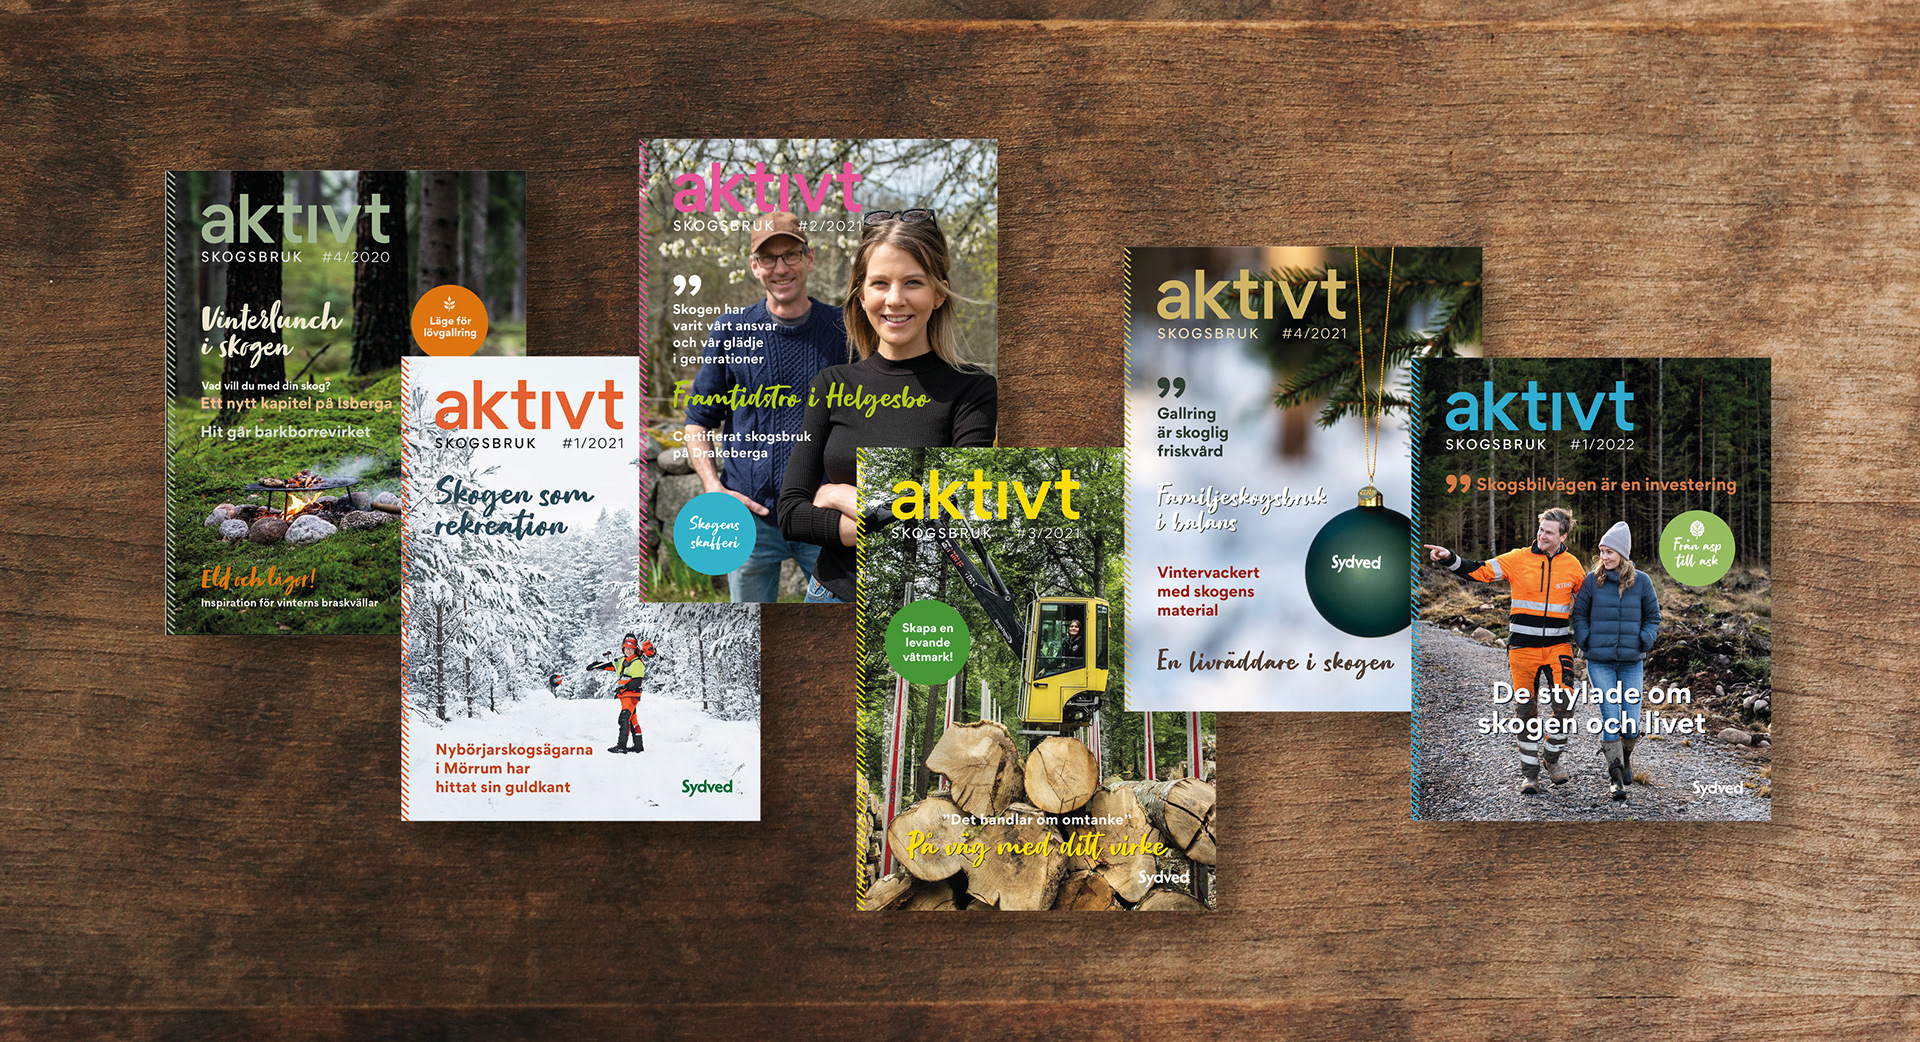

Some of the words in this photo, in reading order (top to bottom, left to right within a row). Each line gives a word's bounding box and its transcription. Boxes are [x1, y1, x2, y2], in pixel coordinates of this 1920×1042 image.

[673, 162, 862, 213] aktivt
[201, 193, 390, 243] aktivt
[673, 220, 774, 232] SKOGSBRUK
[798, 220, 862, 232] #2/2021
[201, 251, 302, 263] SKOGSBRUK
[322, 251, 390, 264] #4/2020
[1157, 269, 1346, 320] aktivt
[201, 300, 343, 332] Vinterlunch
[673, 304, 721, 318] Skogen
[724, 303, 745, 315] har
[430, 316, 454, 328] Läge
[456, 316, 472, 326] för
[673, 320, 703, 331] varit
[706, 319, 733, 331] vårt
[736, 321, 778, 331] ansvar
[424, 327, 477, 339] lövgallring
[1157, 327, 1259, 339] SKOGSBRUK
[1282, 327, 1346, 339] #4/2021
[201, 337, 213, 357] i
[219, 334, 294, 368] skogen
[673, 337, 697, 348] och
[700, 336, 721, 348] vår
[724, 337, 764, 351] glädje
[673, 353, 677, 364] i
[680, 353, 764, 367] generationer
[202, 381, 222, 391] Vad
[224, 381, 240, 391] vill
[241, 381, 255, 391] du
[257, 381, 280, 391] med
[282, 381, 298, 391] din
[301, 381, 331, 393] skog?
[201, 397, 223, 410] Ett
[226, 397, 257, 413] nytt
[261, 396, 312, 413] kapitel
[316, 395, 334, 413] på
[338, 396, 392, 413] Isberga
[435, 379, 624, 430] aktivt
[673, 380, 802, 412] Framtidstro
[808, 386, 819, 408] i
[826, 382, 931, 418] Helgesbo
[1446, 381, 1634, 431] aktivt
[1157, 407, 1216, 423] Gallring
[201, 425, 223, 438] Hit
[227, 424, 252, 441] går
[255, 425, 371, 438] barkborrevirket
[673, 430, 742, 442] Certifierat
[745, 430, 811, 445] skogsbruk
[1157, 426, 1172, 439] är
[1176, 426, 1229, 442] skoglig
[435, 437, 536, 449] SKOGSBRUK
[562, 437, 624, 449] #1/2021
[1157, 444, 1223, 457] friskvård
[1445, 438, 1547, 450] SKOGSBRUK
[1570, 438, 1634, 450] #1/2022
[673, 446, 689, 461] på
[693, 447, 768, 461] Drakeberga
[1477, 477, 1596, 495] Skogsbilvägen
[1601, 479, 1617, 492] är
[1621, 481, 1640, 492] en
[1645, 477, 1737, 495] investering
[435, 475, 533, 516] Skogen
[539, 488, 595, 507] som
[891, 469, 1080, 520] aktivt
[1156, 481, 1328, 514] Familjeskogsbruk
[435, 509, 568, 541] rekreation
[689, 515, 740, 539] Skogens
[1155, 513, 1167, 531] i
[1171, 511, 1238, 533] balans
[891, 527, 992, 539] SKOGSBRUK
[1017, 527, 1081, 539] #3/2021
[690, 535, 740, 550] skafferi
[1673, 536, 1699, 552] Från
[1702, 543, 1722, 555] asp
[1331, 555, 1381, 573] Sydved
[1675, 553, 1697, 569] till
[1699, 555, 1719, 567] ask
[201, 566, 232, 589] Eld
[234, 567, 269, 586] och
[267, 565, 316, 595] lågor!
[1157, 566, 1260, 579] Vintervackert
[1157, 585, 1190, 598] med
[1194, 585, 1255, 601] skogens
[201, 598, 257, 610] Inspiration
[259, 598, 275, 607] för
[277, 598, 319, 607] vinterns
[322, 598, 378, 608] braskvällar
[1157, 604, 1218, 617] material
[902, 622, 937, 636] Skapa
[939, 624, 954, 633] en
[906, 637, 950, 648] levande
[903, 650, 953, 662] våtmark!
[1157, 648, 1182, 671] En
[1189, 650, 1299, 672] livräddare
[1306, 653, 1316, 670] i
[1324, 651, 1394, 680] skogen
[1493, 681, 1531, 706] De
[1538, 681, 1642, 711] stylade
[1648, 689, 1691, 705] om
[1478, 711, 1578, 741] skogen
[1586, 711, 1638, 735] och
[1645, 712, 1706, 735] livet
[436, 743, 593, 759] Nybörjarskogsägarna
[436, 762, 440, 774] i
[444, 762, 502, 774] Mörrum
[507, 762, 530, 774] har
[436, 781, 476, 793] hittat
[480, 781, 501, 793] sin
[505, 781, 571, 796] guldkant
[681, 779, 733, 797] Sydved
[1692, 780, 1744, 798] Sydved
[980, 813, 1033, 825] handlar
[1036, 816, 1058, 825] om
[906, 829, 939, 859] På
[945, 832, 991, 868] väg
[998, 832, 1054, 858] med
[1060, 831, 1106, 860] ditt
[1110, 831, 1169, 857] virke
[1139, 870, 1190, 887] Sydved
